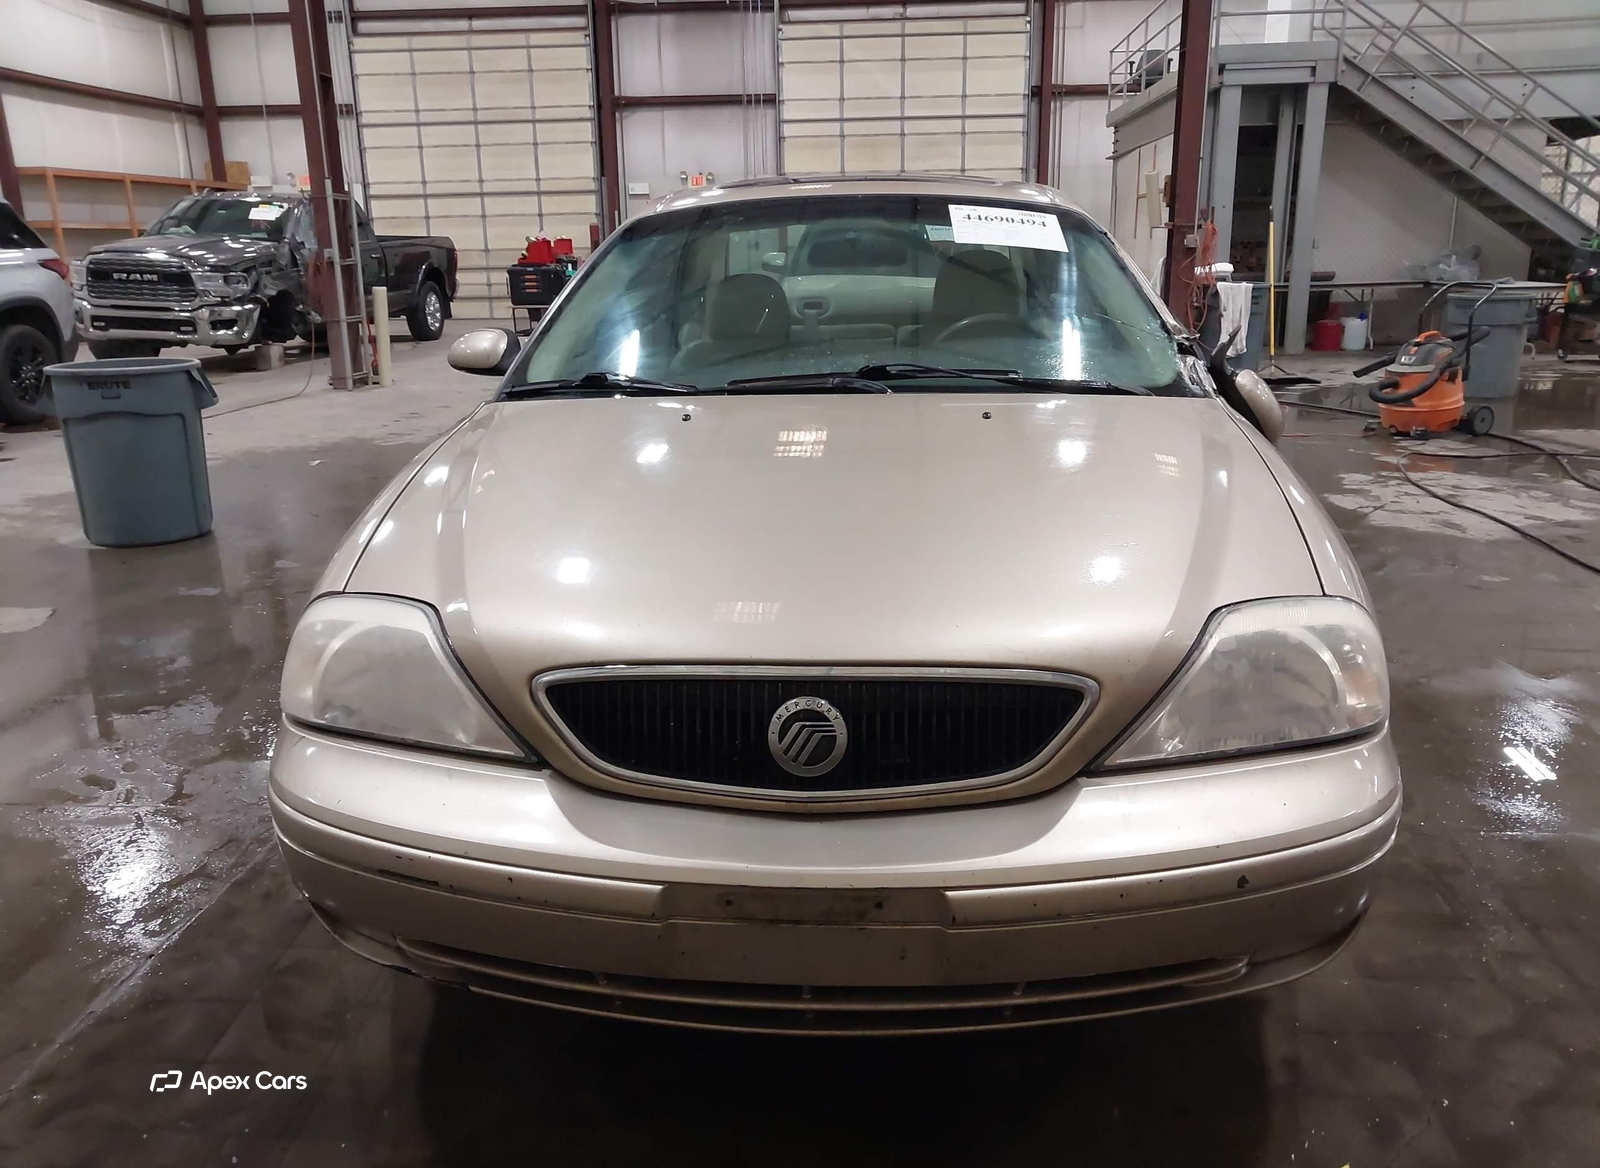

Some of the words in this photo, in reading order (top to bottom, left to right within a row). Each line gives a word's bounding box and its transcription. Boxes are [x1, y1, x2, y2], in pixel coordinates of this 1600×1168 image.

[962, 213, 1047, 228] 44690494
[112, 272, 159, 282] RAM
[775, 699, 843, 722] MERCURY
